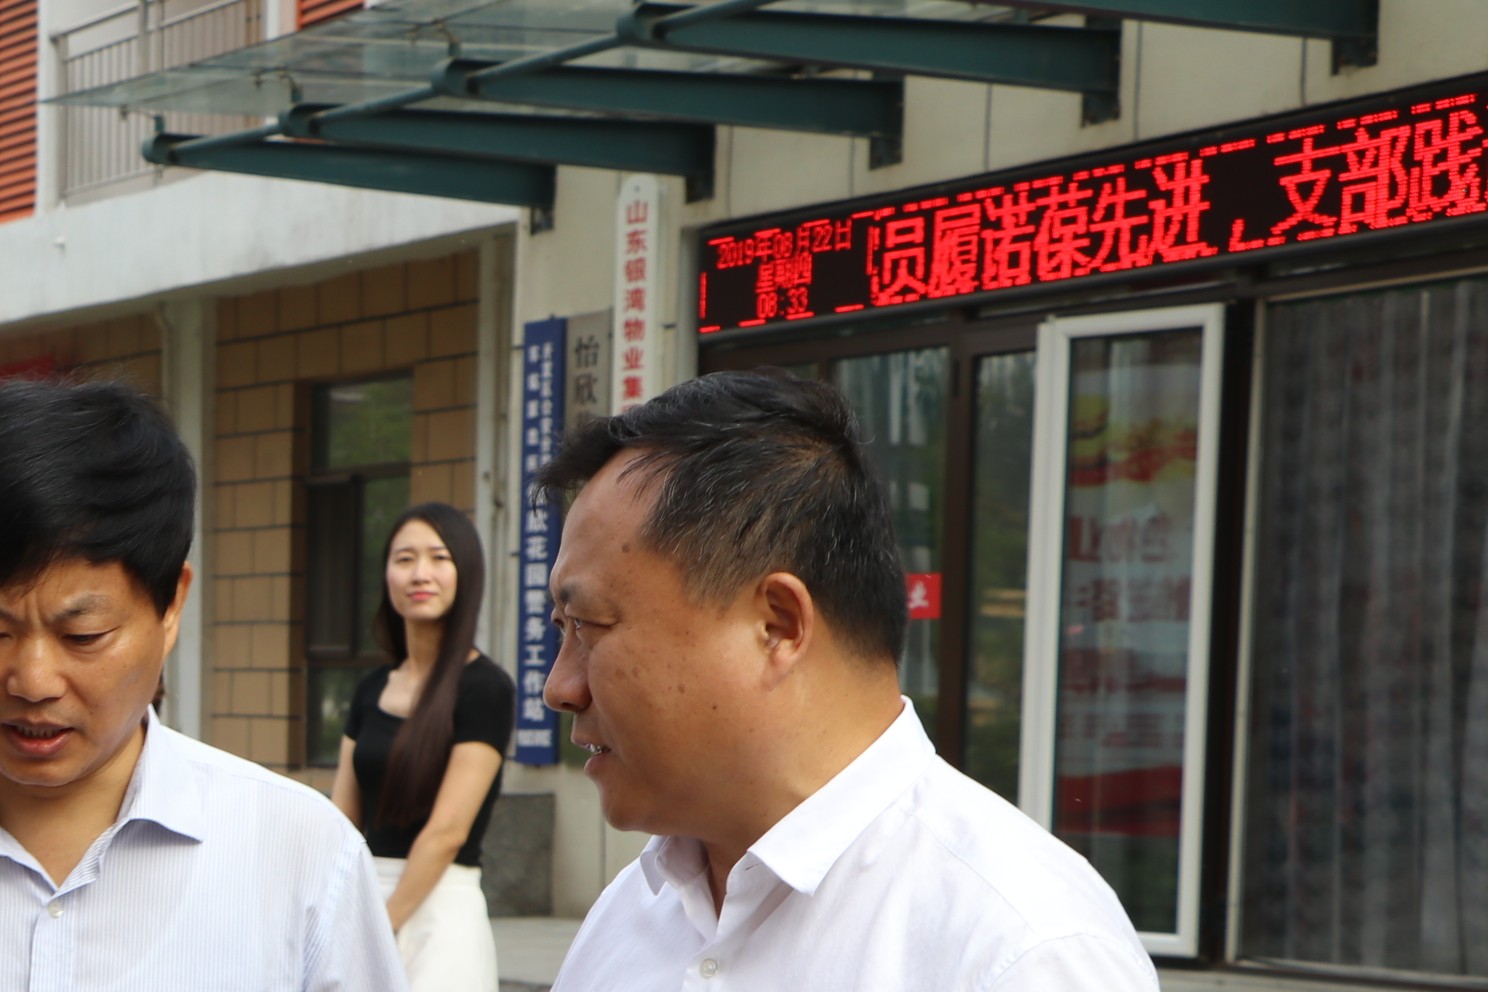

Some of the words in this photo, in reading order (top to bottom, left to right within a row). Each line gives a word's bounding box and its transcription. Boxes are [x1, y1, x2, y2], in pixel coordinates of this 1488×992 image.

[755, 252, 812, 294] 星期四
[756, 287, 809, 319] 08:33
